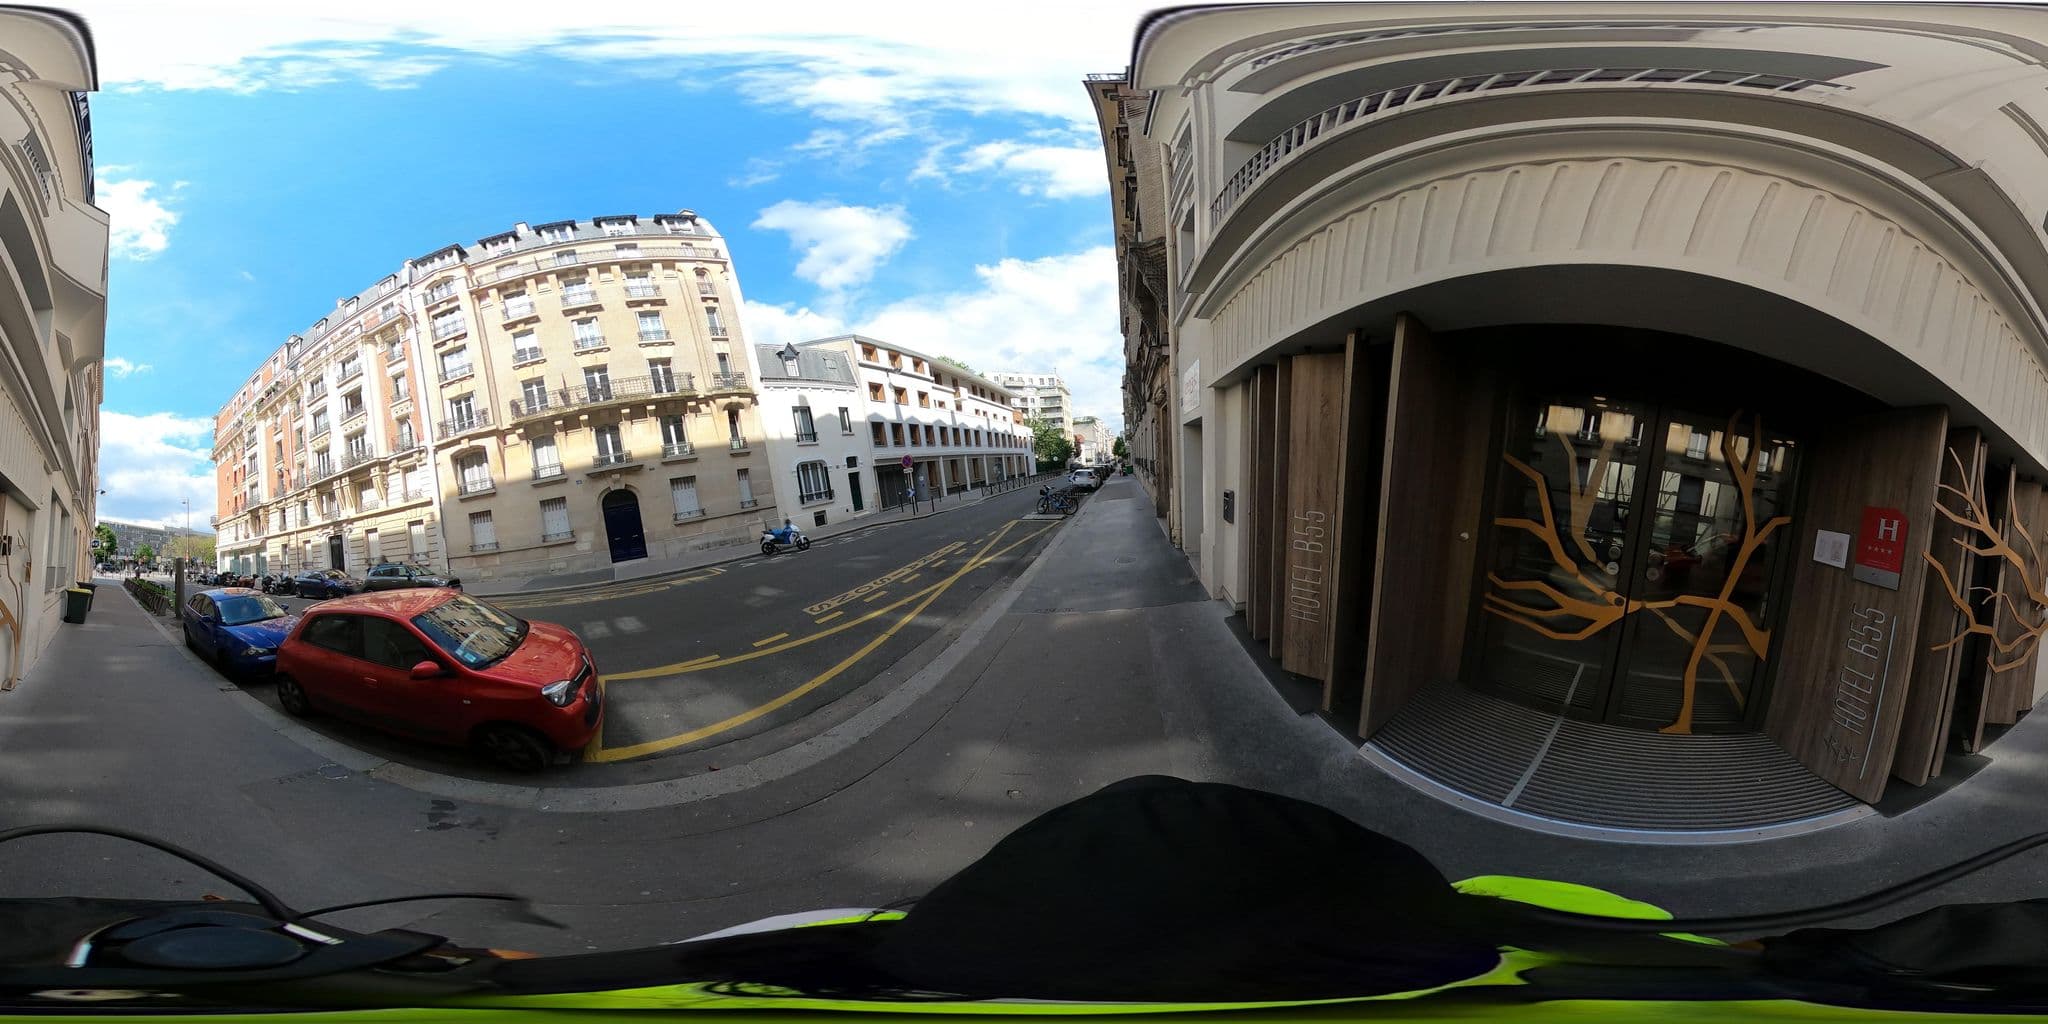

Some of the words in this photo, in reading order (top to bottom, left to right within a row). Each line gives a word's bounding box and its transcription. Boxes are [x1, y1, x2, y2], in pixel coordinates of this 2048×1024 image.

[1293, 510, 1325, 553] B55
[1878, 518, 1899, 541] H
[809, 543, 960, 613] AISONS
[1291, 565, 1322, 623] HOTEL
[1848, 603, 1886, 659] B55
[1833, 666, 1876, 735] HOTEL
